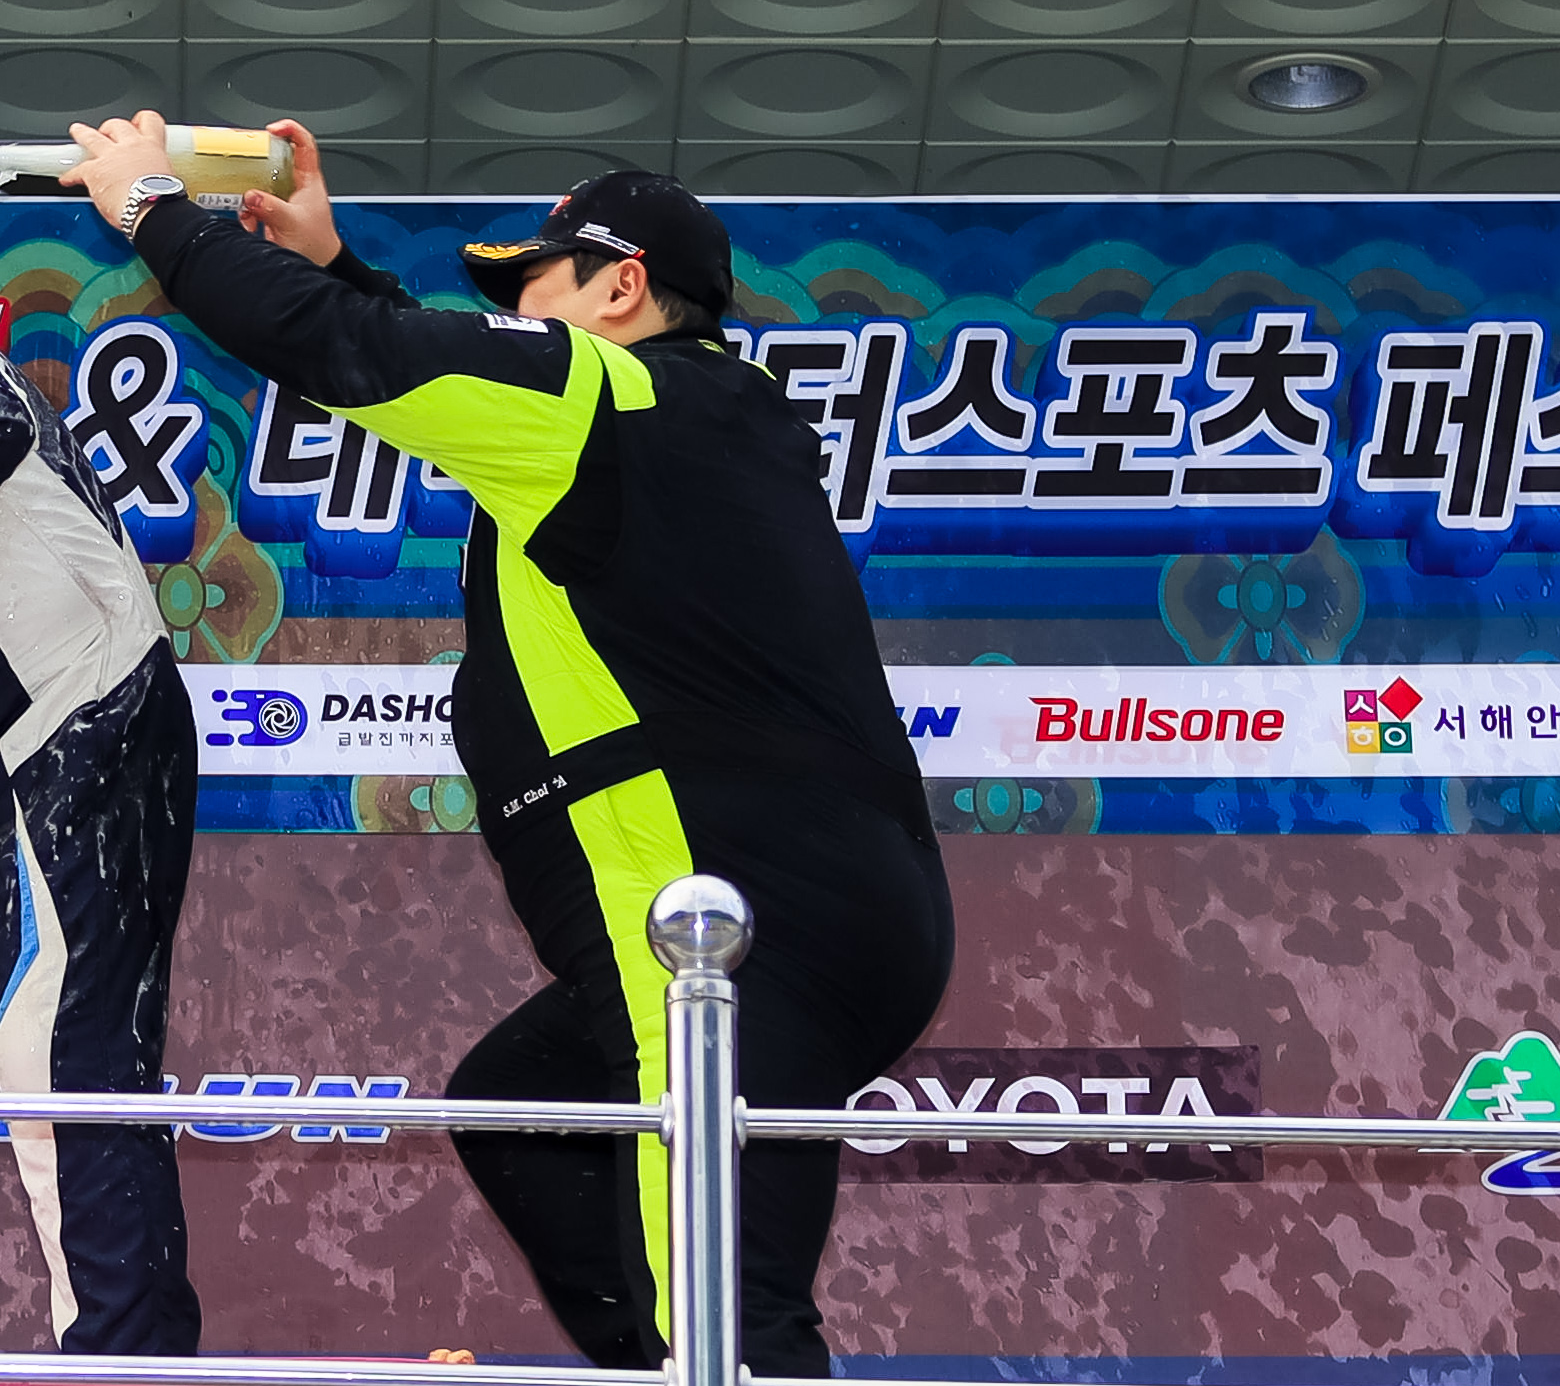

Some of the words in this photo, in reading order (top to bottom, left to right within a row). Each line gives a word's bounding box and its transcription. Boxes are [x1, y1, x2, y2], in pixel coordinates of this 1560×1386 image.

[68, 333, 194, 505] &
[725, 321, 1326, 523] 터스포츠
[1028, 698, 1285, 742] Bullsone
[840, 1075, 1233, 1155] OYOTA
